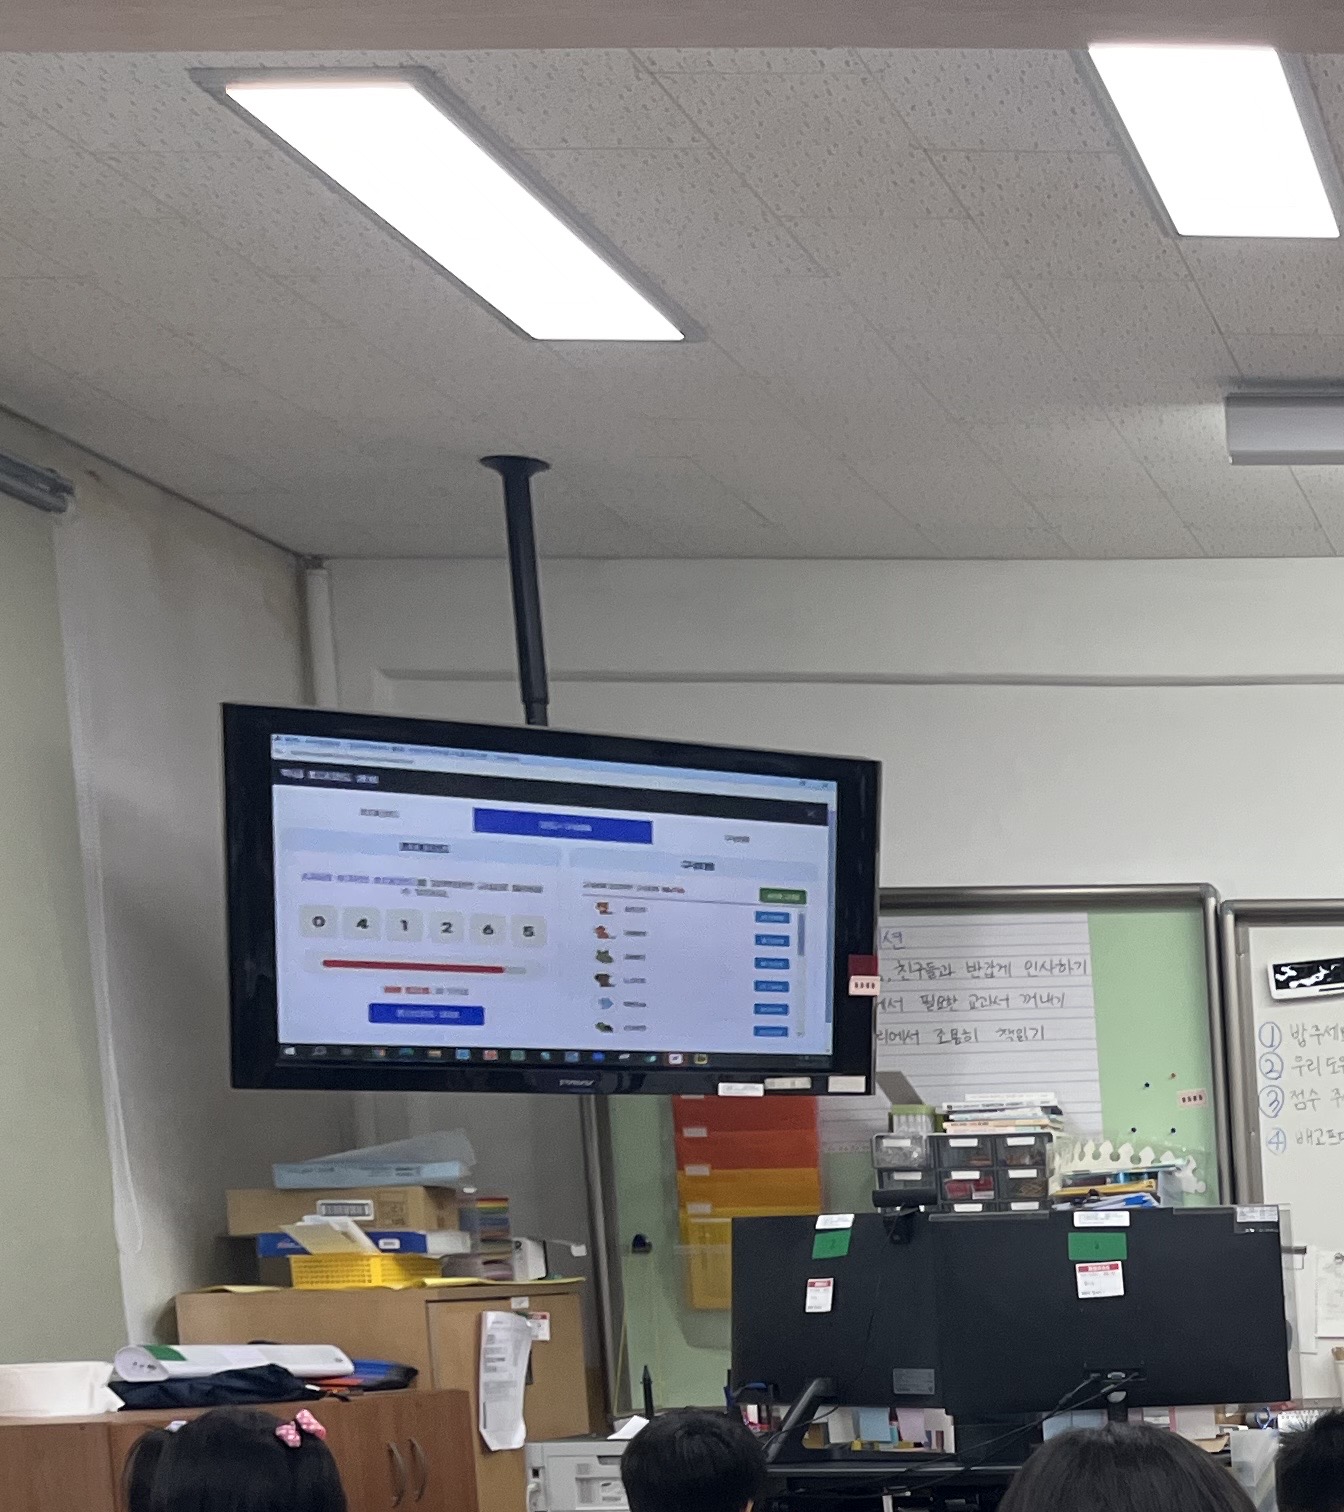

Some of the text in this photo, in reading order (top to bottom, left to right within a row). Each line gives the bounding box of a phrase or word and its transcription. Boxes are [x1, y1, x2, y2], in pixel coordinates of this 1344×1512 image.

[311, 915, 326, 928] 0
[355, 917, 369, 930] 4
[400, 919, 409, 932] 1
[441, 921, 454, 934] 2
[482, 924, 494, 936] 6
[1024, 958, 1088, 978] 인사하기
[1290, 1055, 1322, 1077] 우리
